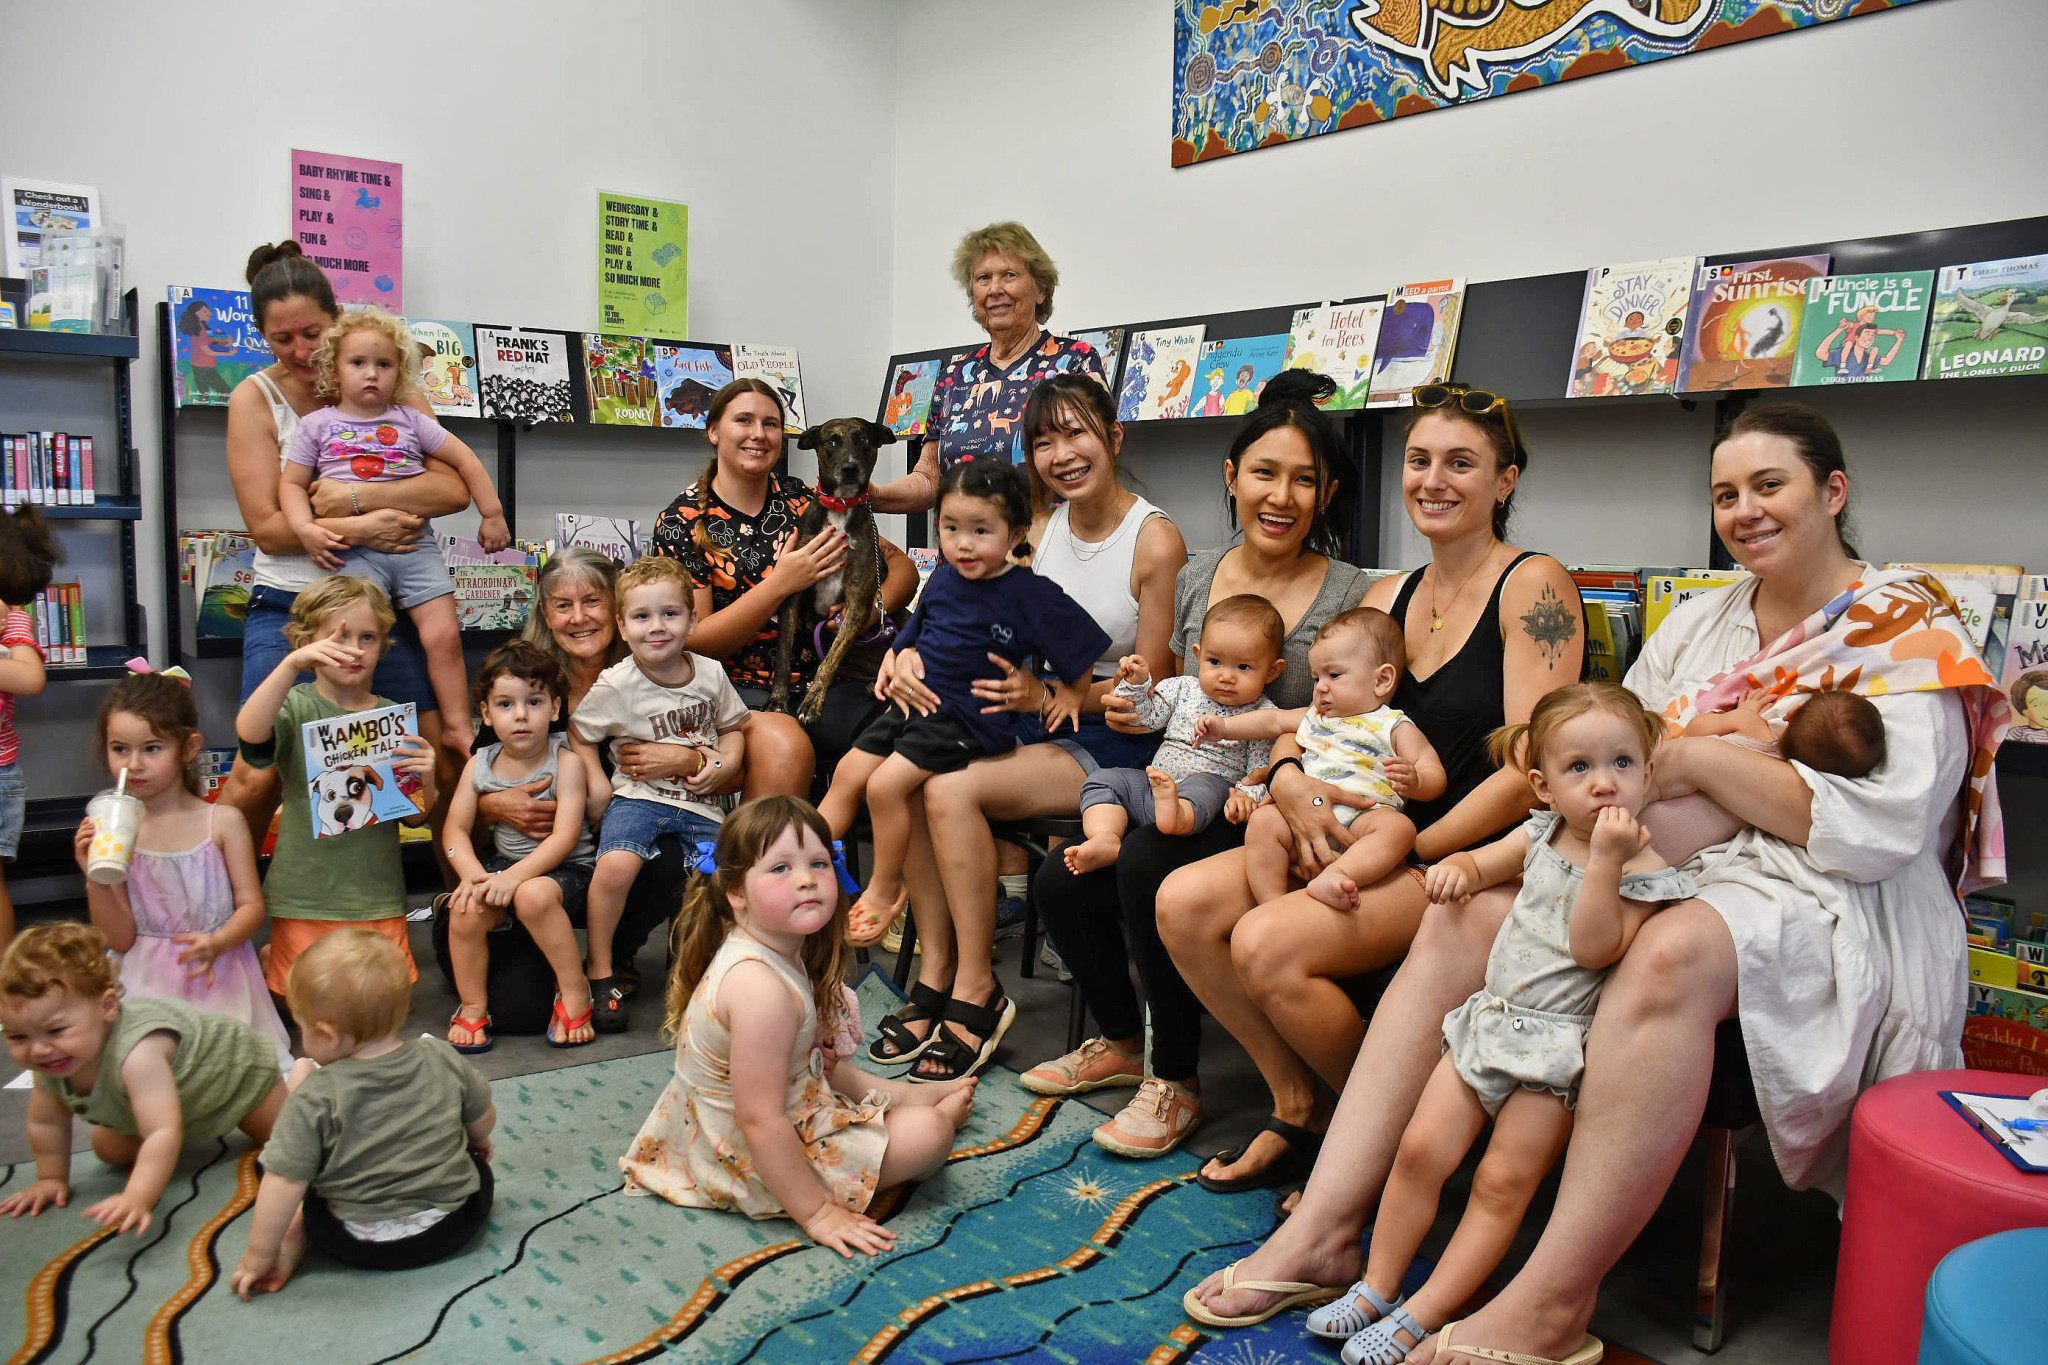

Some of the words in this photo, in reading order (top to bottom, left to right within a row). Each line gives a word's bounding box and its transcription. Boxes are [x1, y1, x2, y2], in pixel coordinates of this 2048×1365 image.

[299, 163, 324, 178] BABY
[326, 167, 359, 183] RHYME
[361, 172, 382, 186] TIME
[384, 175, 392, 187] &
[24, 191, 53, 201] Check
[299, 187, 322, 201] SING
[323, 189, 331, 201] &
[21, 199, 83, 212] Wonderbook!
[605, 200, 650, 217] WEDNESDAY
[652, 207, 659, 218] &
[299, 209, 323, 222] PLAY
[326, 212, 334, 224] &
[605, 214, 630, 228] STORY
[631, 218, 649, 231] TIME
[651, 221, 658, 232] &
[300, 232, 318, 245] FUN
[319, 234, 327, 246] &
[605, 229, 625, 241] READ
[627, 232, 634, 243] &
[605, 243, 623, 256] SING
[626, 246, 632, 257] &
[314, 255, 342, 270] MUCH
[343, 258, 370, 272] MORE
[605, 257, 624, 270] PLAY
[626, 260, 633, 271] &
[2002, 263, 2040, 273] THOMAS
[1602, 267, 1610, 278] P
[1709, 268, 1718, 279] S
[1732, 268, 1773, 284] First
[1958, 267, 1967, 280] T
[605, 272, 615, 283] SO
[616, 274, 639, 286] MUCH
[640, 276, 661, 289] MORE
[1613, 274, 1653, 299] STAY
[1824, 278, 1833, 291] T
[1838, 277, 1879, 291] Uncle
[1883, 277, 1897, 290] is
[1901, 278, 1912, 288] a
[183, 288, 190, 297] A
[1405, 285, 1420, 296] EED
[1427, 284, 1450, 295] parrot
[1712, 277, 1808, 303] Sunrise
[235, 296, 248, 310] 11
[1609, 294, 1660, 322] DINNER
[1828, 287, 1923, 315] FUNCLE
[1301, 311, 1310, 321] M
[1329, 309, 1365, 330] Hotel
[246, 323, 260, 335] fo
[488, 331, 494, 339] A
[496, 336, 549, 351] FRANK'S
[1155, 338, 1171, 347] Tiny
[1174, 335, 1195, 345] Whale
[1321, 334, 1335, 348] for
[1336, 329, 1366, 349] Bees
[436, 340, 461, 356] BIG
[662, 347, 668, 355] D
[1208, 343, 1215, 351] K
[497, 350, 524, 363] RED
[525, 352, 550, 364] HAT
[1940, 346, 2046, 372] LEONARD
[737, 360, 759, 371] OLD
[759, 358, 795, 369] PEOPLE
[1940, 371, 1960, 379] THE
[1962, 367, 2007, 377] LONELY
[2009, 362, 2041, 373] DUCK
[1820, 376, 1846, 384] CHRIS
[1847, 374, 1884, 383] THOMAS
[615, 407, 652, 421] RODNEY
[567, 515, 574, 523] C
[229, 539, 236, 548] A
[449, 536, 456, 545] B
[449, 567, 455, 575] B
[455, 577, 518, 588] XTRAORDINARY
[1664, 580, 1672, 593] S
[465, 589, 501, 599] GARDENER
[318, 724, 330, 738] W
[321, 712, 406, 752] KAMBO'S
[212, 753, 219, 762] B
[210, 779, 217, 788] B
[2028, 946, 2043, 962] W
[1979, 987, 1990, 1001] Y
[1965, 1025, 2022, 1054] Goldy
[1964, 1050, 2013, 1069] Three
